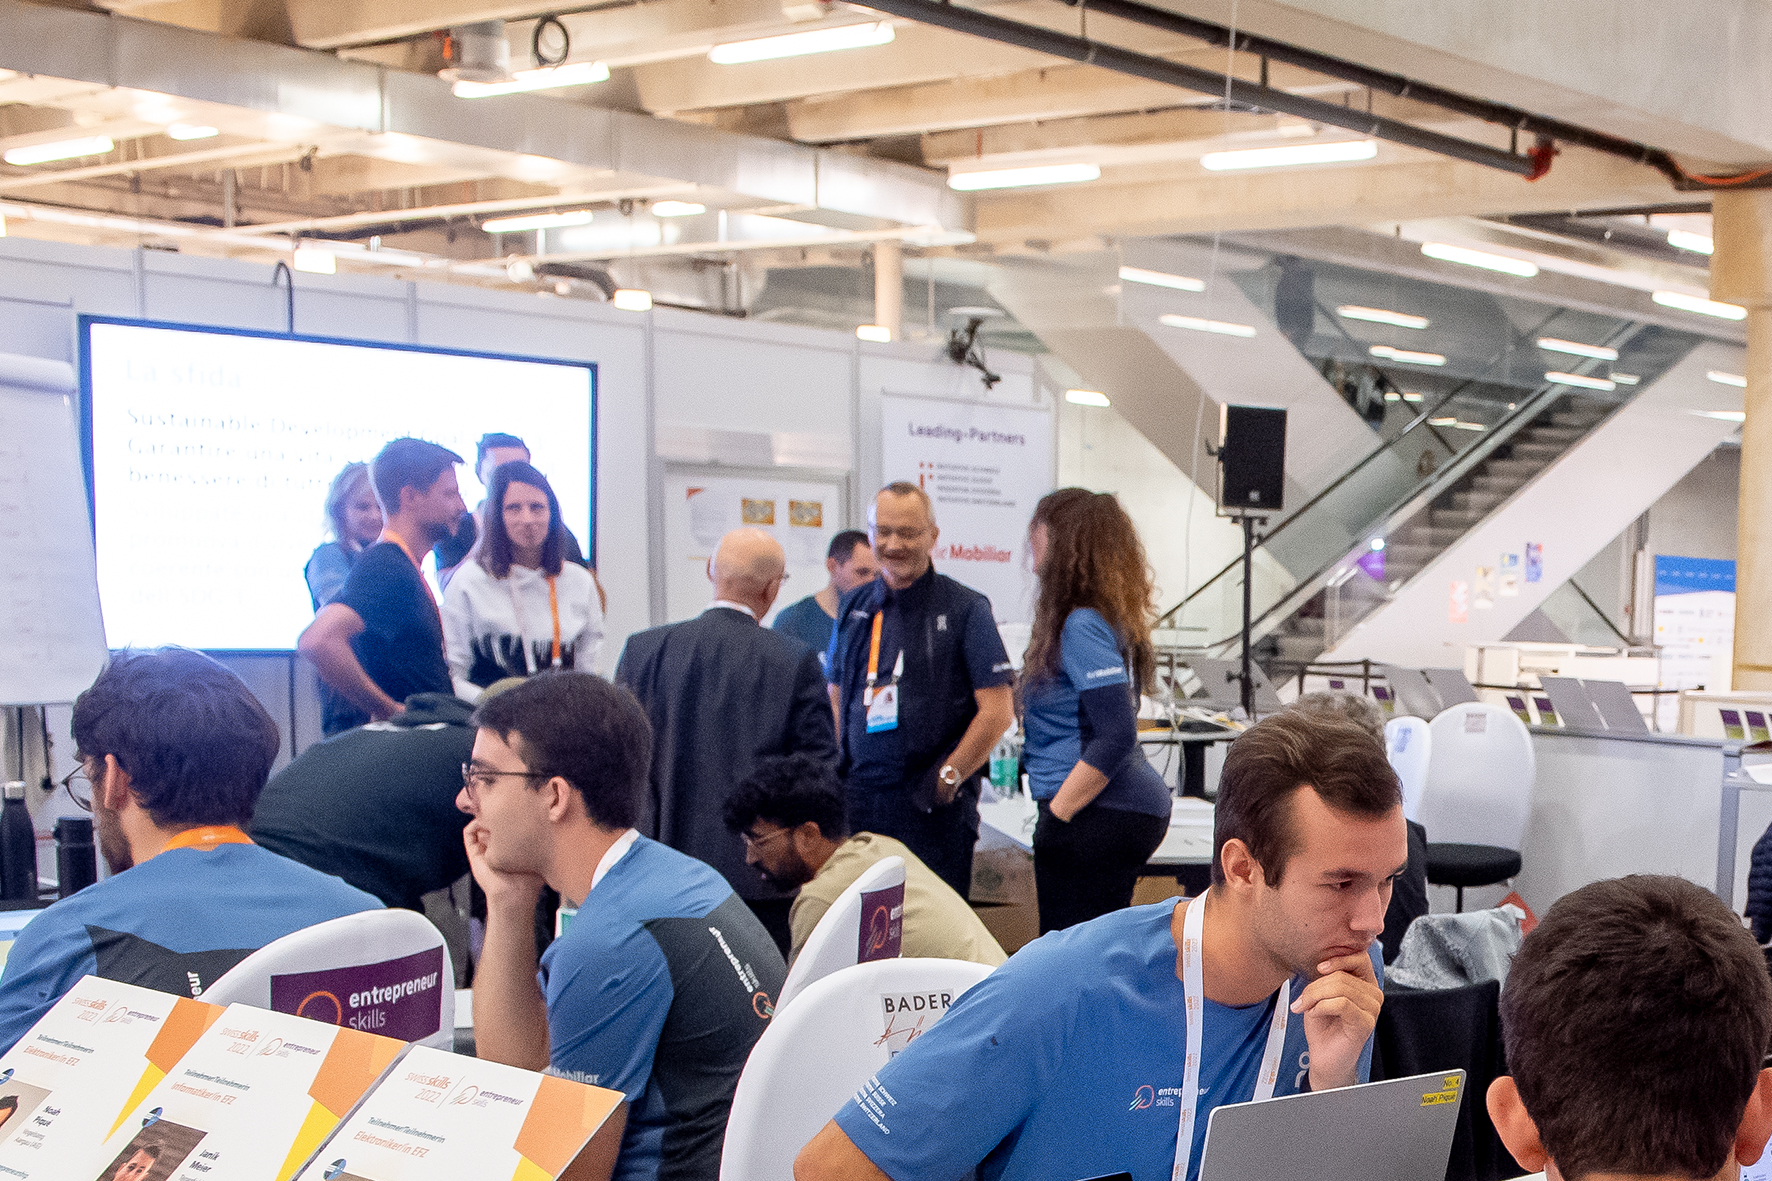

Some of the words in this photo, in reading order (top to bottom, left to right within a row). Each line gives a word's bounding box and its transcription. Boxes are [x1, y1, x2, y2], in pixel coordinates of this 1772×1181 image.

[908, 421, 1025, 446] Leading-Partners
[951, 544, 1011, 563] Mobiliar
[708, 926, 753, 993] entrepreneur
[349, 971, 438, 1008] entrepreneur
[884, 993, 952, 1014] BADER
[349, 1010, 386, 1030] skills
[220, 1027, 260, 1042] swissskills
[226, 1041, 250, 1055] 2022
[283, 1041, 321, 1056] entrepreneur
[404, 1071, 452, 1090] swissskills
[414, 1088, 442, 1104] 2022
[479, 1090, 524, 1106] entrepreneur
[1155, 1098, 1175, 1107] skills
[42, 1105, 61, 1117] Noah
[860, 1102, 891, 1135] SWITZERLAND
[354, 1131, 413, 1156] Elektroniker/in
[411, 1146, 430, 1159] EFZ
[199, 1149, 220, 1161] Janik
[189, 1160, 212, 1173] Meier
